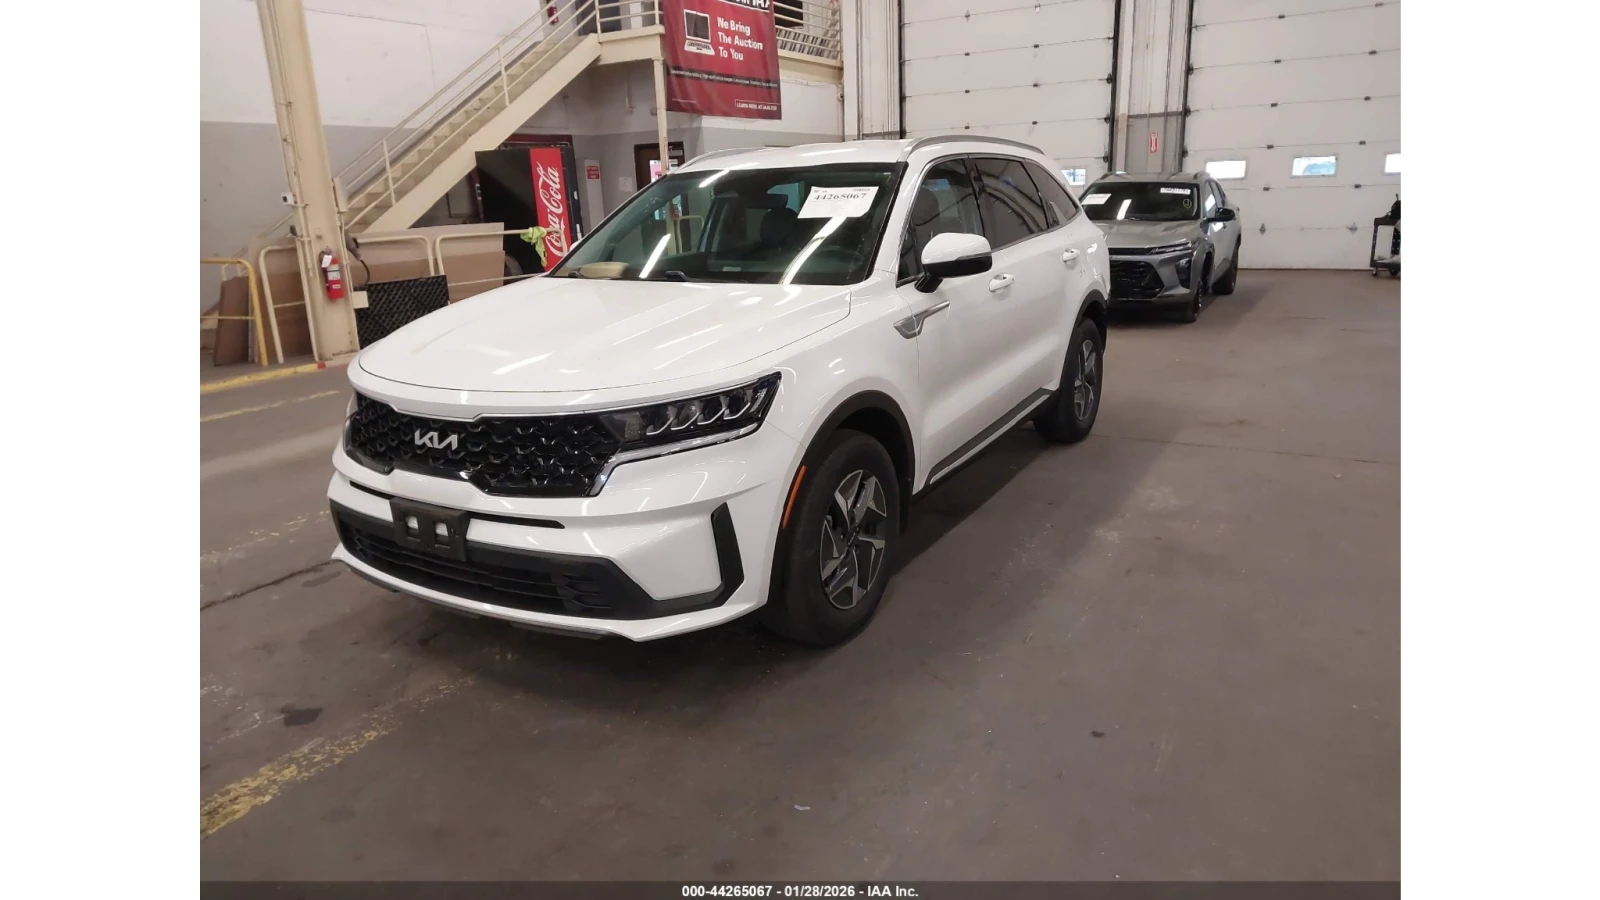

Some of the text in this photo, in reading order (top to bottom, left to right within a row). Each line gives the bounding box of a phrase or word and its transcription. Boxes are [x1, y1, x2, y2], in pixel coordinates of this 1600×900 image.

[717, 16, 751, 36] We Bring
[717, 32, 763, 50] The Auction
[718, 46, 744, 60] To You
[414, 428, 458, 451] KIA
